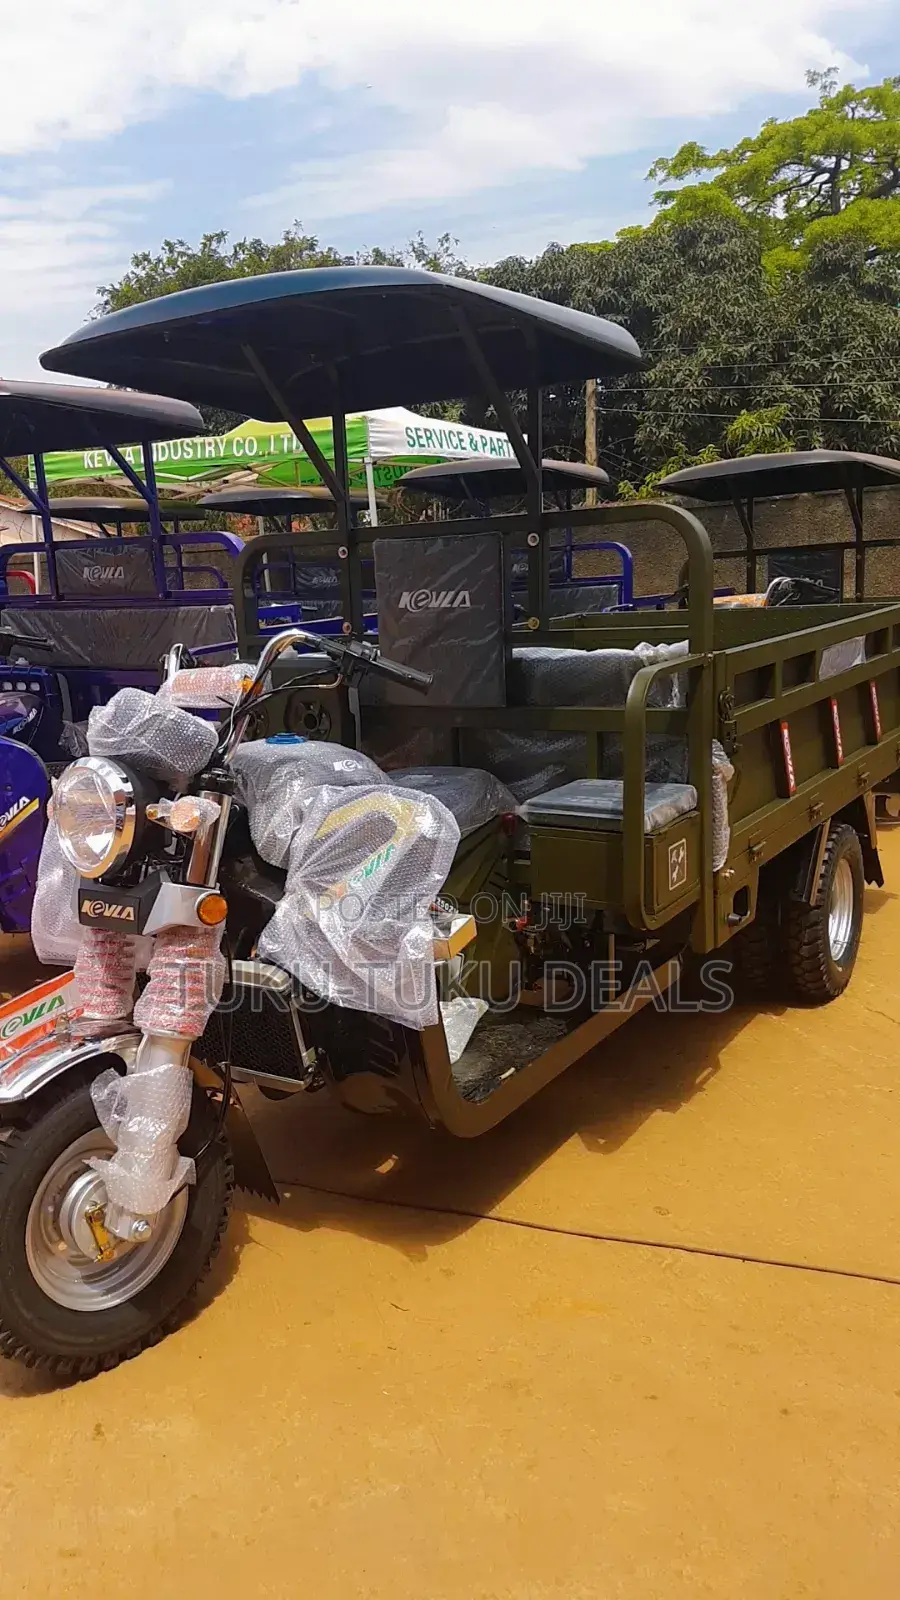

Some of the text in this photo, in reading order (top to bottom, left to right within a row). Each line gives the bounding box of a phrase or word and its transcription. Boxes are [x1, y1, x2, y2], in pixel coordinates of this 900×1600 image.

[84, 448, 135, 469] KEVA
[140, 437, 226, 464] IDUSTRY
[405, 426, 517, 458] SERVICE & PART
